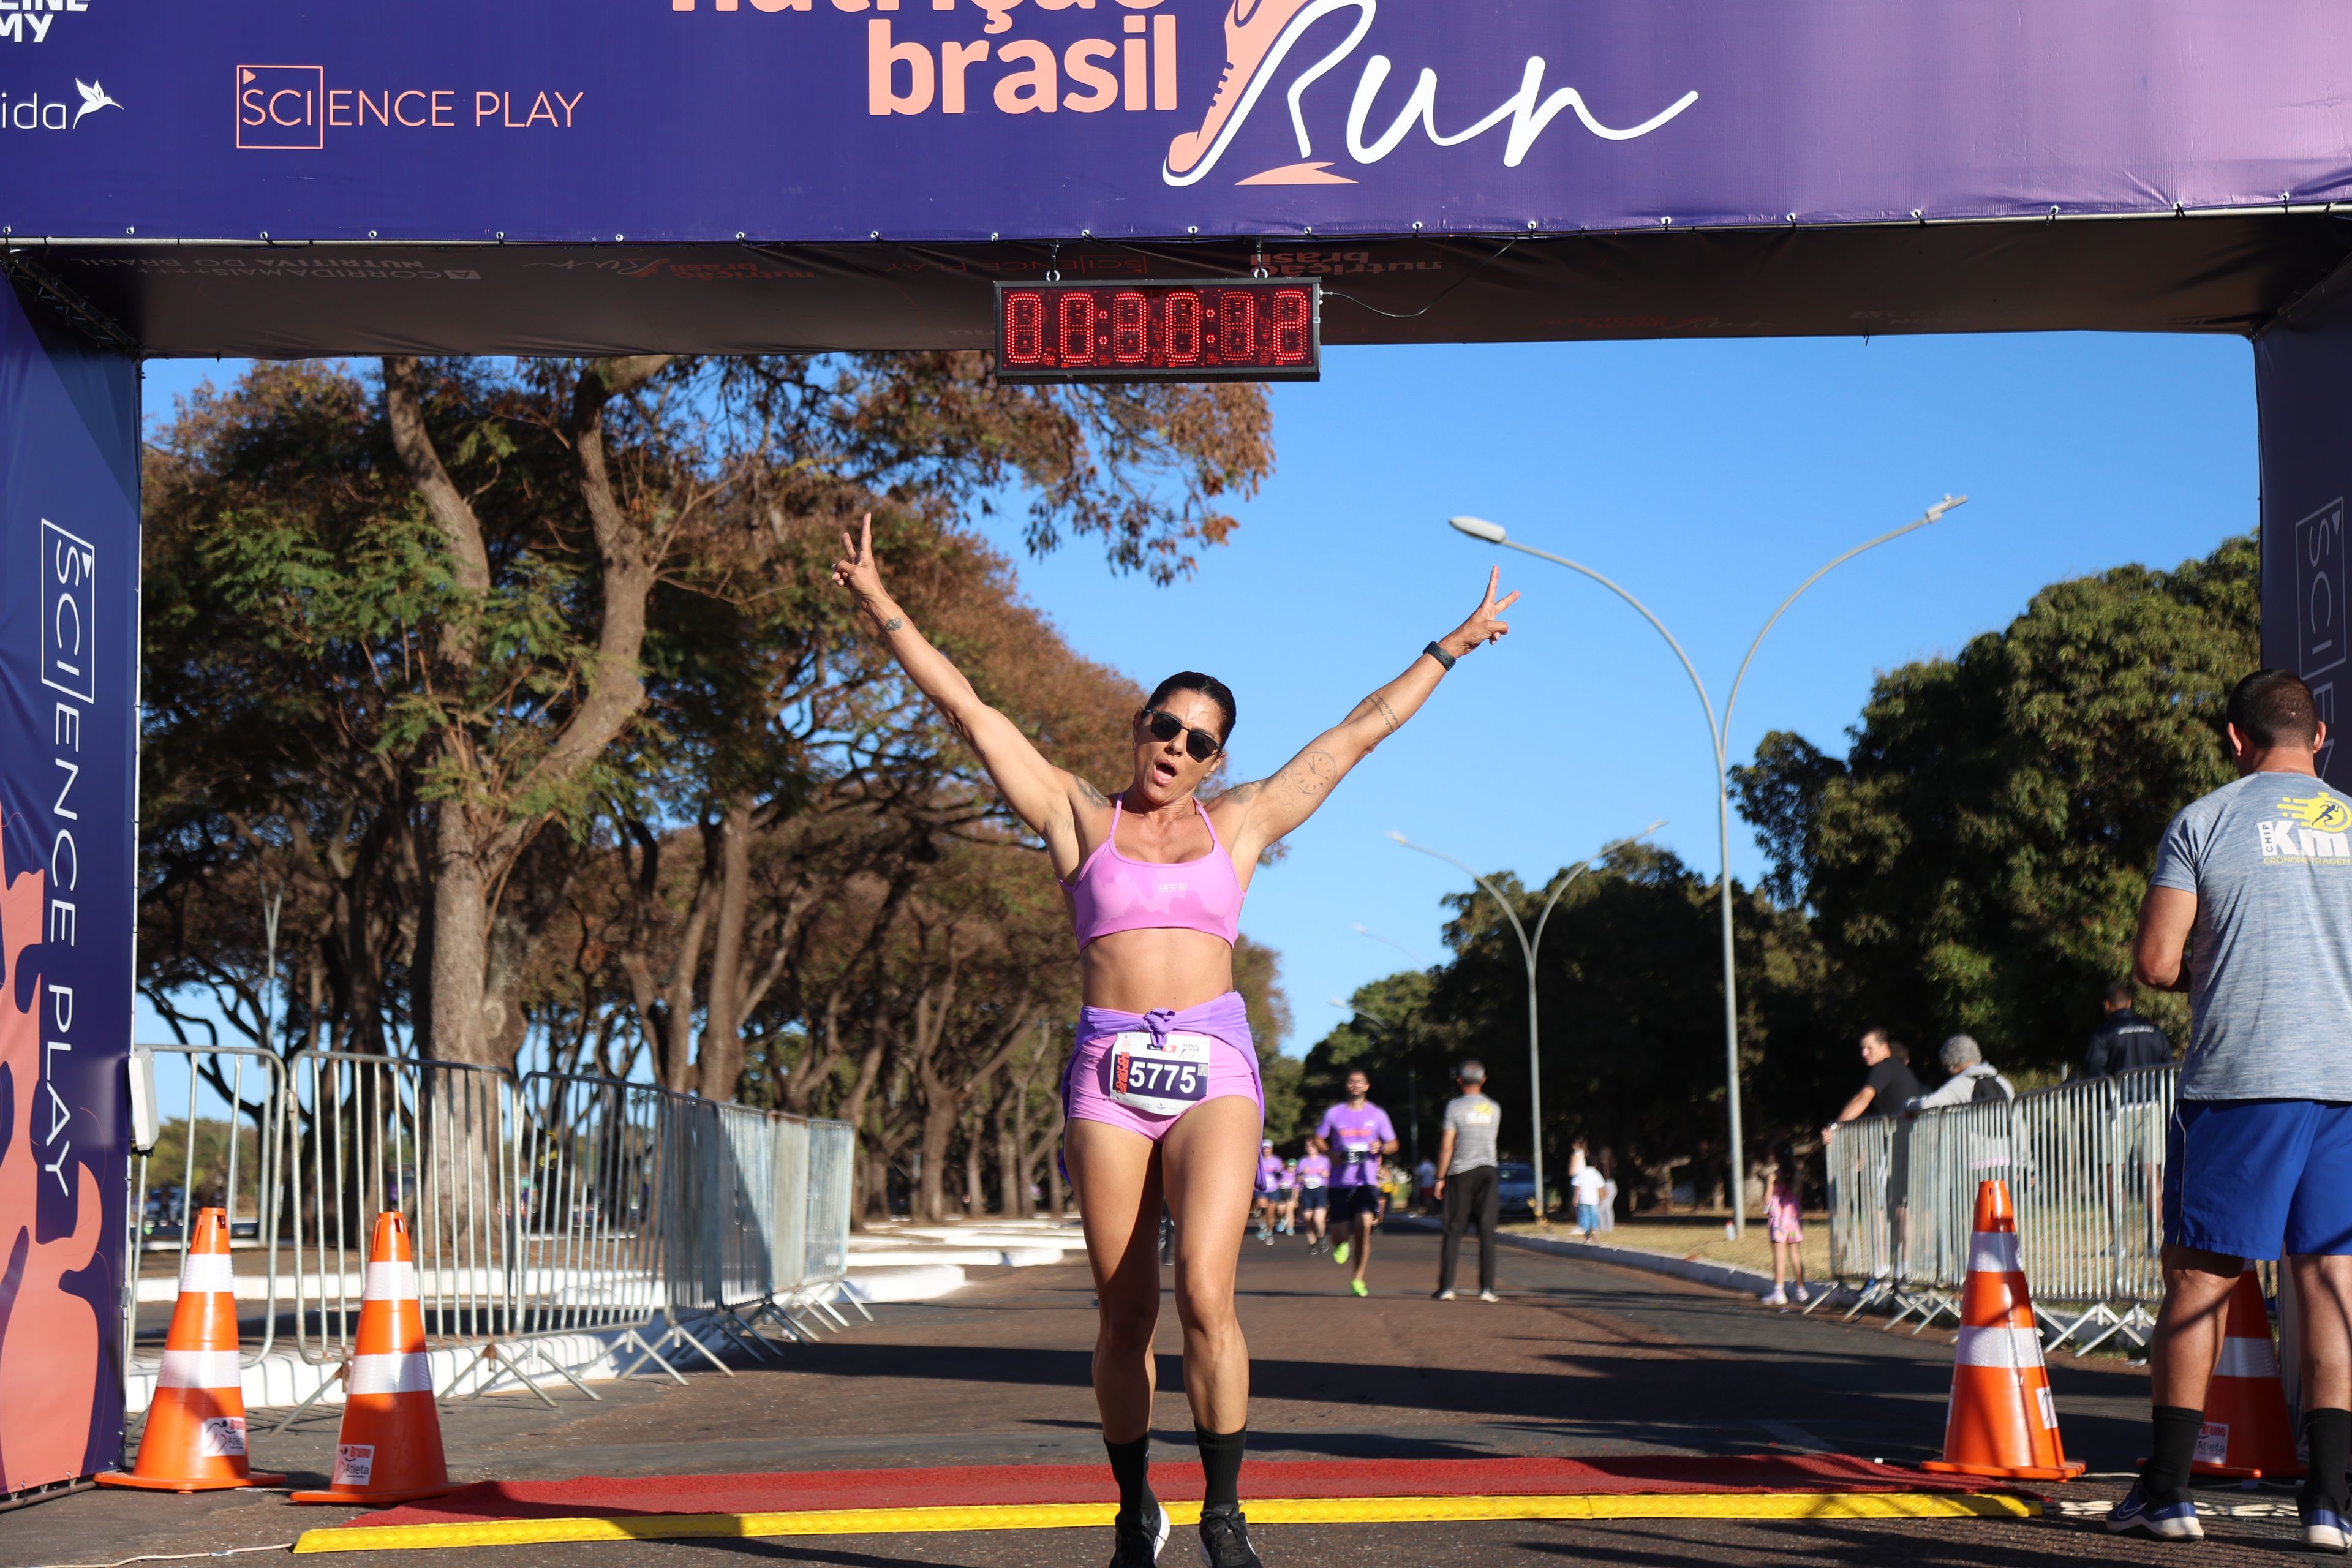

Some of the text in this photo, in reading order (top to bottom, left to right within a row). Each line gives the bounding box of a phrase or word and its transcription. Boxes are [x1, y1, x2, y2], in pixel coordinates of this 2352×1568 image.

[869, 15, 1177, 116] brasil
[243, 89, 584, 128] SCIENCE PLAY
[1162, 0, 1699, 187] Run
[70, 258, 424, 268] NUTRITIVA DO BRASIL
[669, 262, 758, 273] brasil
[886, 261, 968, 273] PLAY
[2309, 518, 2335, 780] SCIE
[2262, 824, 2274, 853] CHIP
[45, 537, 80, 1198] SCIENCE PLAY
[2263, 856, 2351, 865] CRONOMETRAGEM
[1129, 1061, 1196, 1094] 5775
